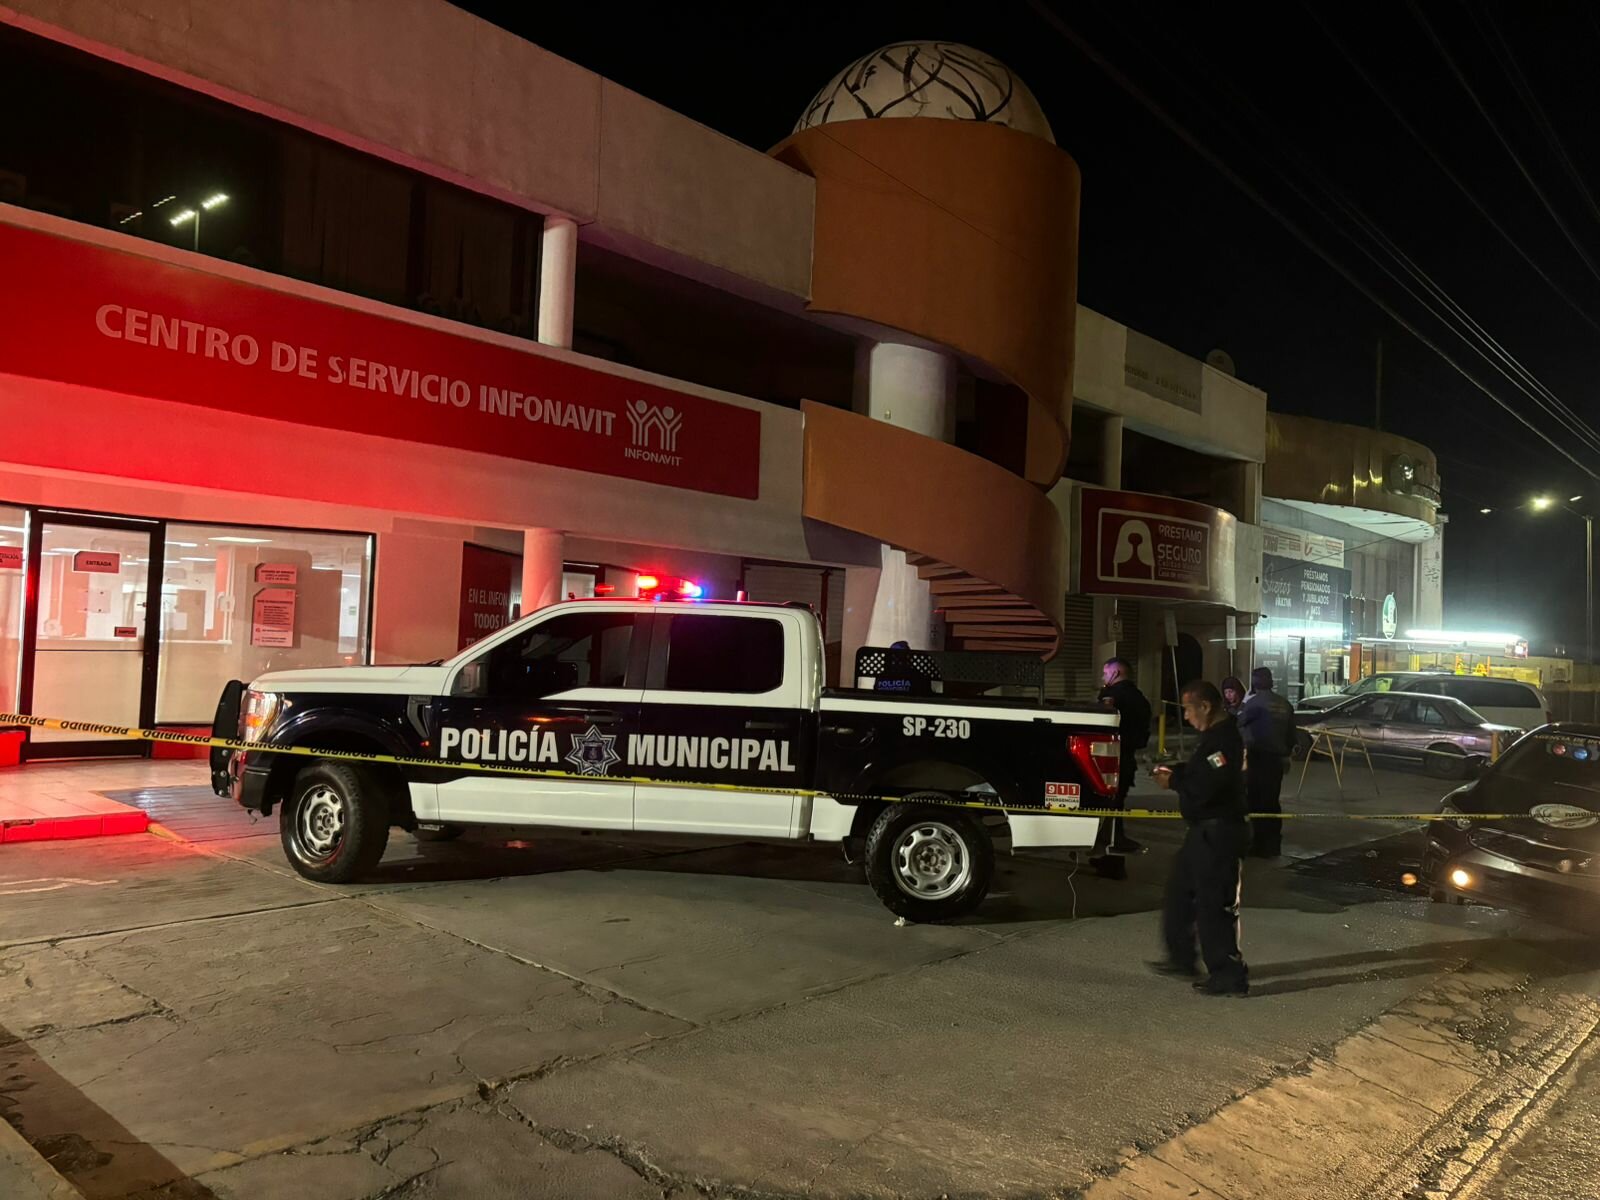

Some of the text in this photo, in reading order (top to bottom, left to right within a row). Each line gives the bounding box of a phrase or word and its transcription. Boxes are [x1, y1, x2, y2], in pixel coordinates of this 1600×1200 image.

[95, 304, 617, 436] CENTRO DE SERVICIO INFONAVIT
[624, 446, 682, 467] INFONAVIT
[1157, 543, 1201, 564] SEGURO
[1303, 567, 1329, 583] PRÉSTAMOS
[468, 588, 478, 604] EN
[480, 590, 487, 605] EL
[1300, 580, 1331, 594] PENSIONADOS
[1306, 594, 1329, 605] JUBILADOS
[474, 613, 499, 630] TODOS
[60, 720, 129, 735] PROHIBIDO
[142, 730, 210, 743] PROHIBIDO
[903, 716, 970, 739] SP-230
[440, 725, 796, 772] POLICÍA MUNICIPAL
[1048, 785, 1076, 795] 911
